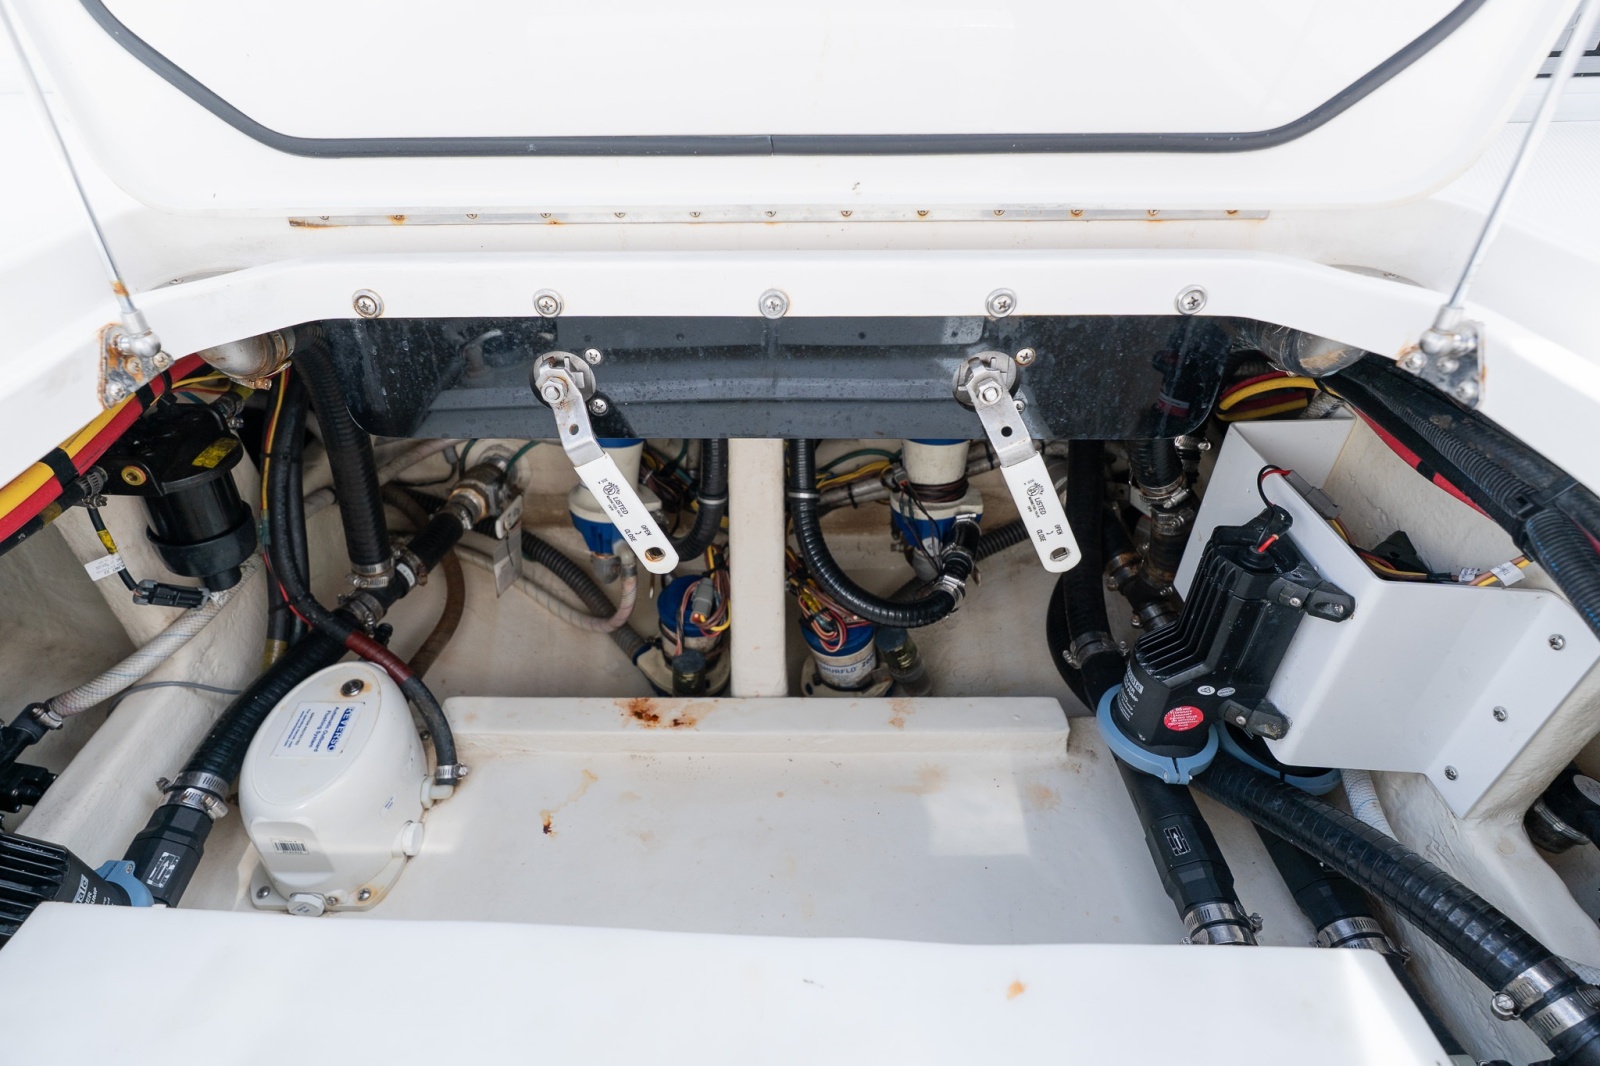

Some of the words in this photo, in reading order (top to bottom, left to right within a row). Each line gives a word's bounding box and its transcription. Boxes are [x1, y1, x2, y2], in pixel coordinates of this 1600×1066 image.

[613, 496, 629, 515] LISTED
[1034, 497, 1047, 516] LISTED
[624, 528, 638, 542] CLOSE
[640, 524, 653, 537] OPEN
[1036, 528, 1048, 542] CLOSE
[1054, 524, 1064, 536] OPEN
[317, 709, 332, 730] Flushing
[325, 706, 340, 730] Automatic
[327, 706, 354, 752] REVERSO
[308, 730, 322, 748] System
[313, 729, 329, 752] Outboard
